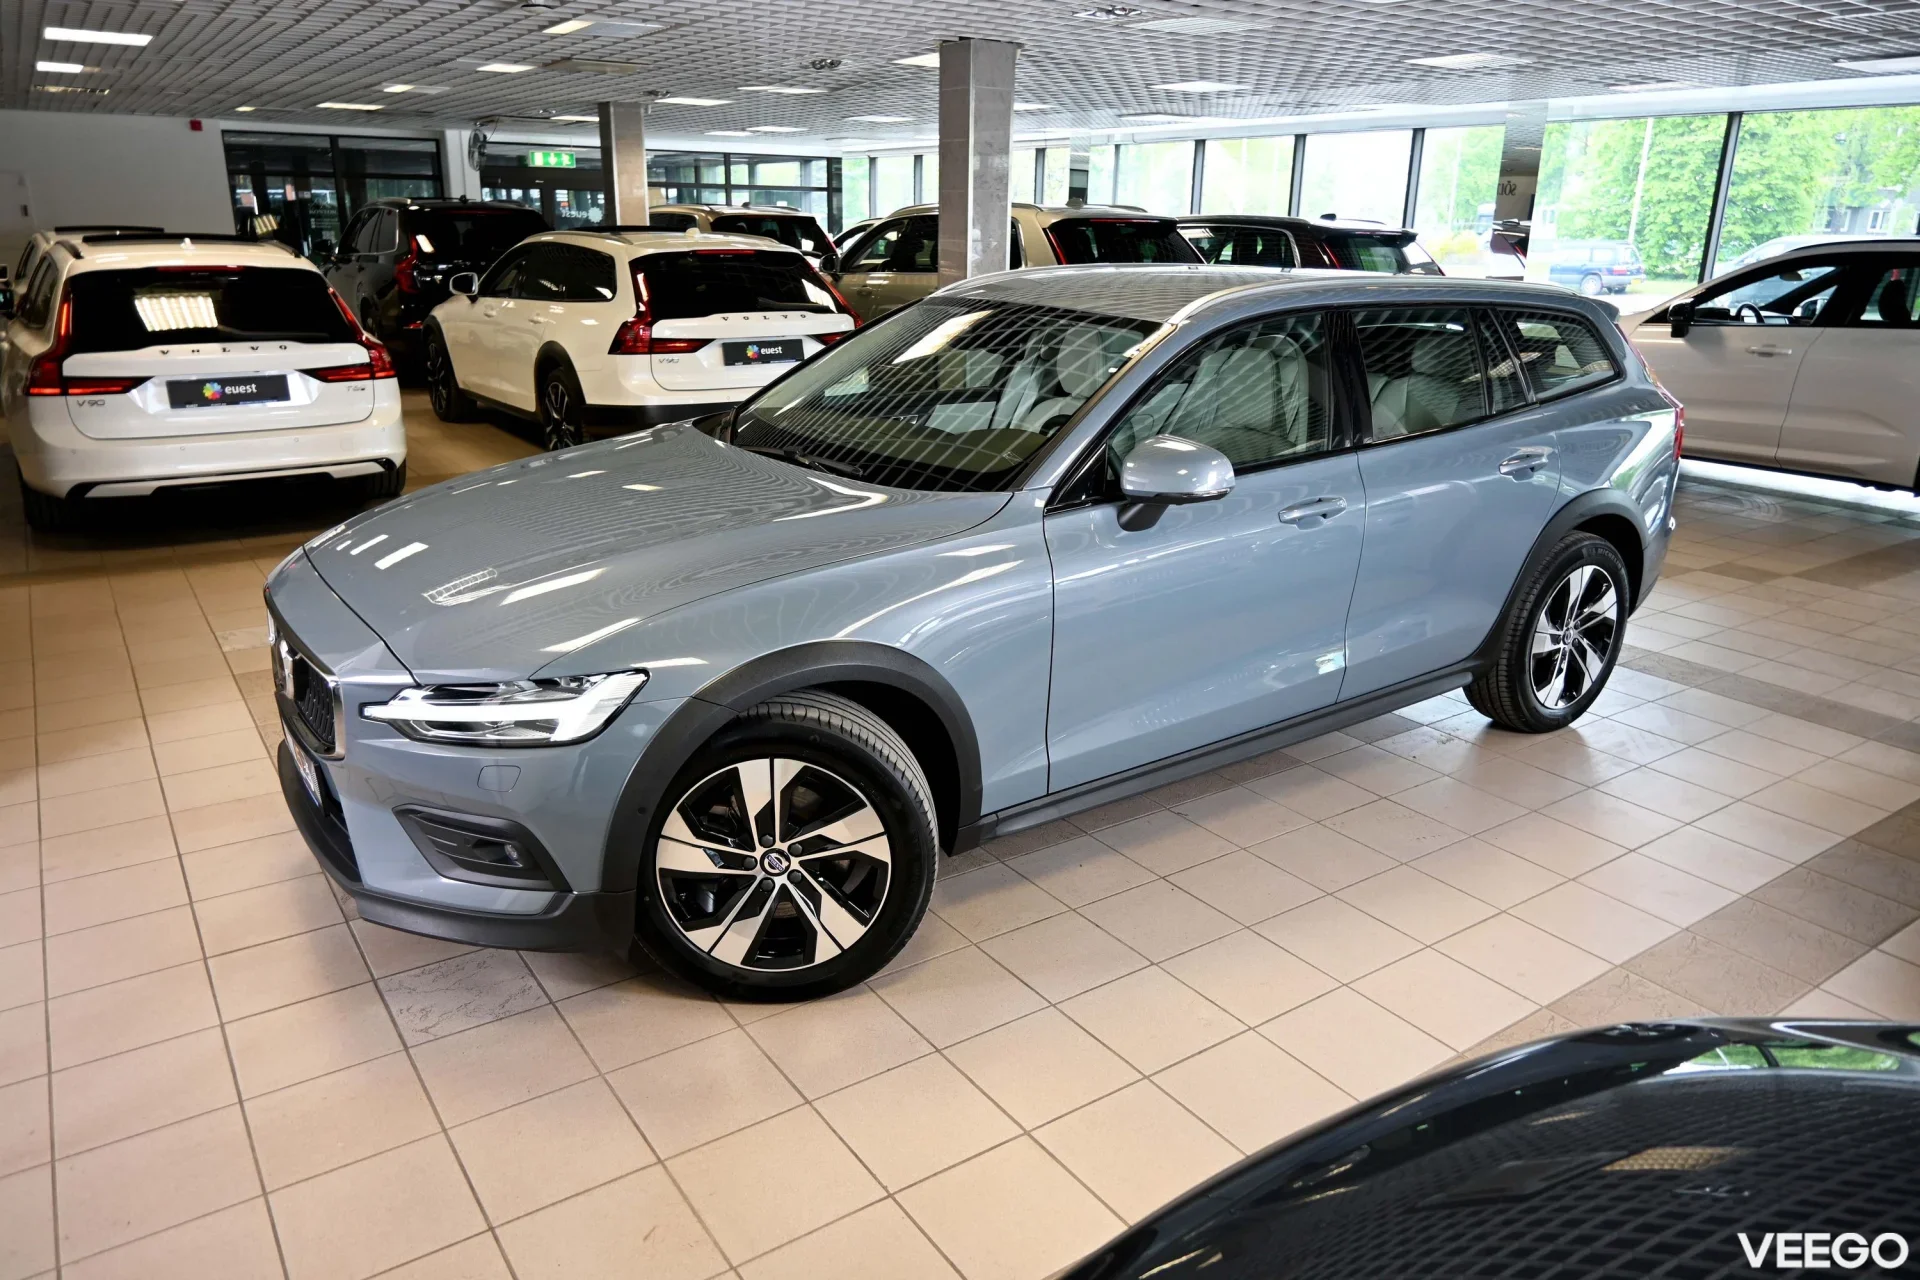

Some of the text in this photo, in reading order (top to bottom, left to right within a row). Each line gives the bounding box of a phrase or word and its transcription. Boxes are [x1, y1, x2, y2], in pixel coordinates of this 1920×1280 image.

[721, 313, 807, 321] VOLVO
[160, 344, 288, 355] VOLVO
[760, 346, 782, 355] euest
[224, 383, 257, 395] euest
[76, 399, 106, 407] V90
